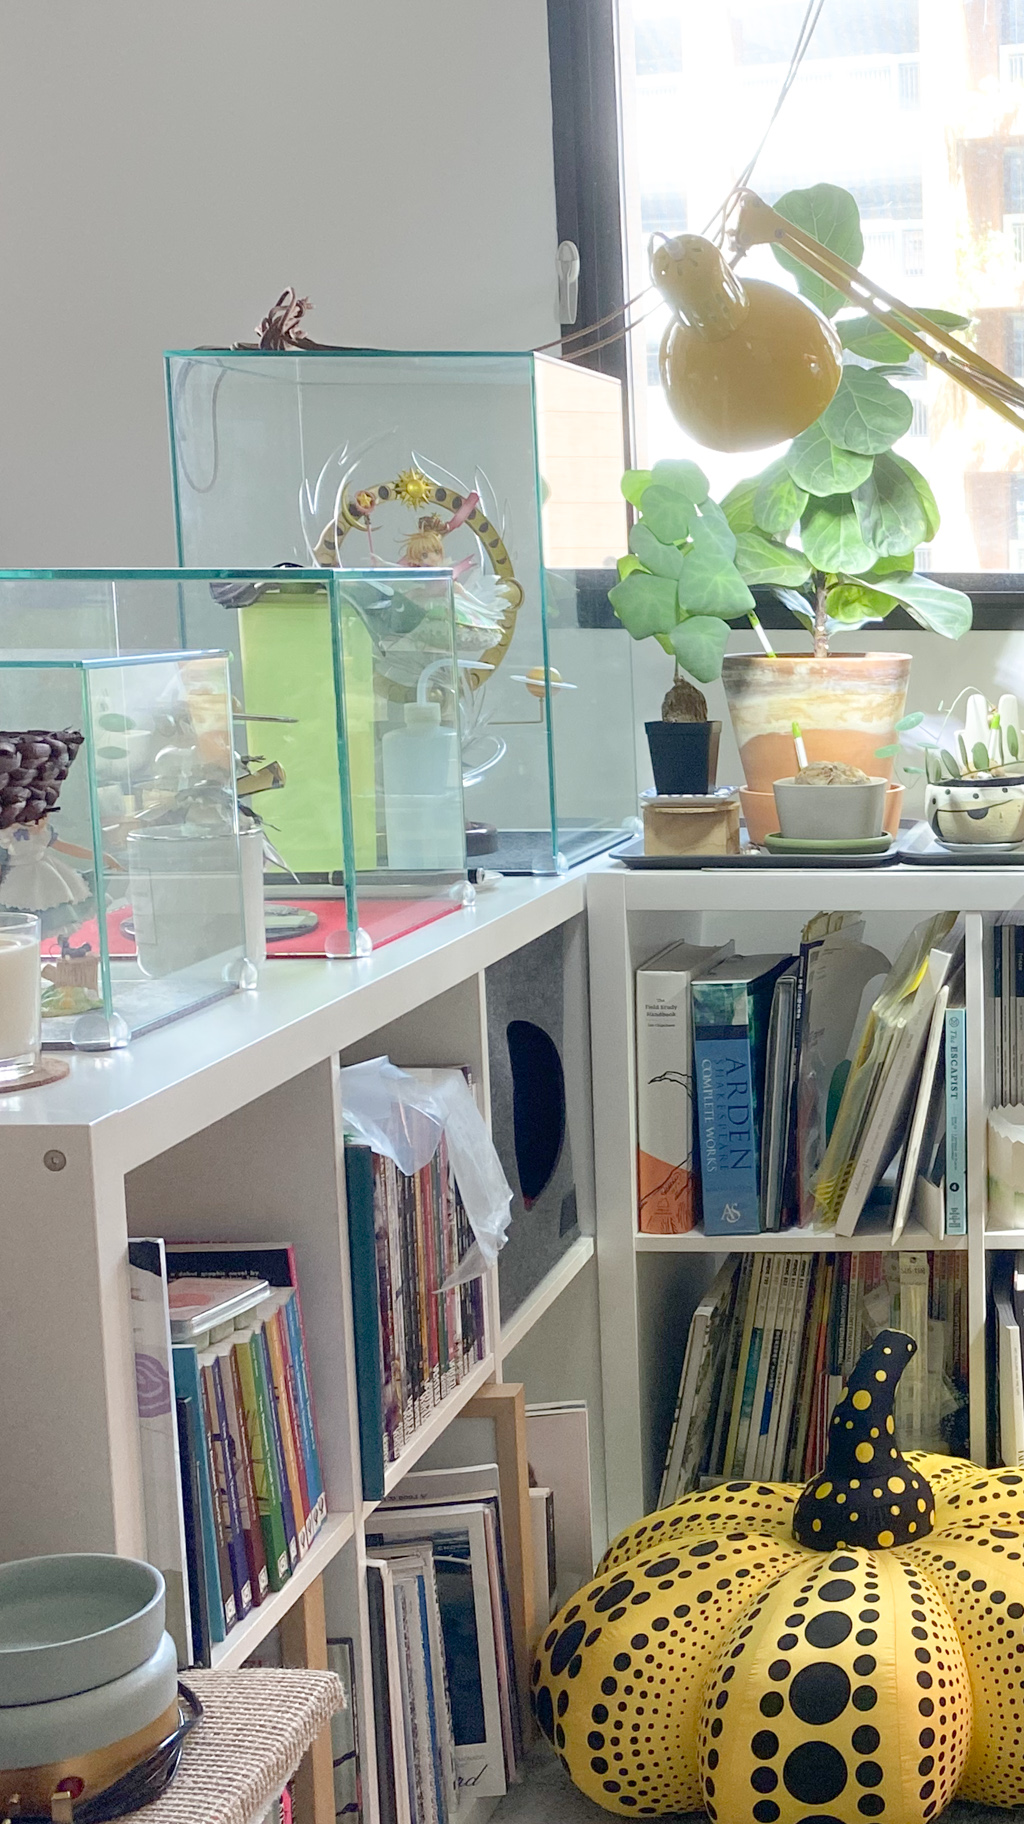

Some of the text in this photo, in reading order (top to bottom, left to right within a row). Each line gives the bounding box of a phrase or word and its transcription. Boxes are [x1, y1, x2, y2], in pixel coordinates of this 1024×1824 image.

[701, 1058, 718, 1173] COMPLETE WORKS
[715, 1058, 730, 1171] SHAKESPEARE
[725, 1057, 752, 1171] ARDEN
[949, 1030, 959, 1100] The ESCAPIST
[838, 1318, 846, 1364] INTERNATIONAL
